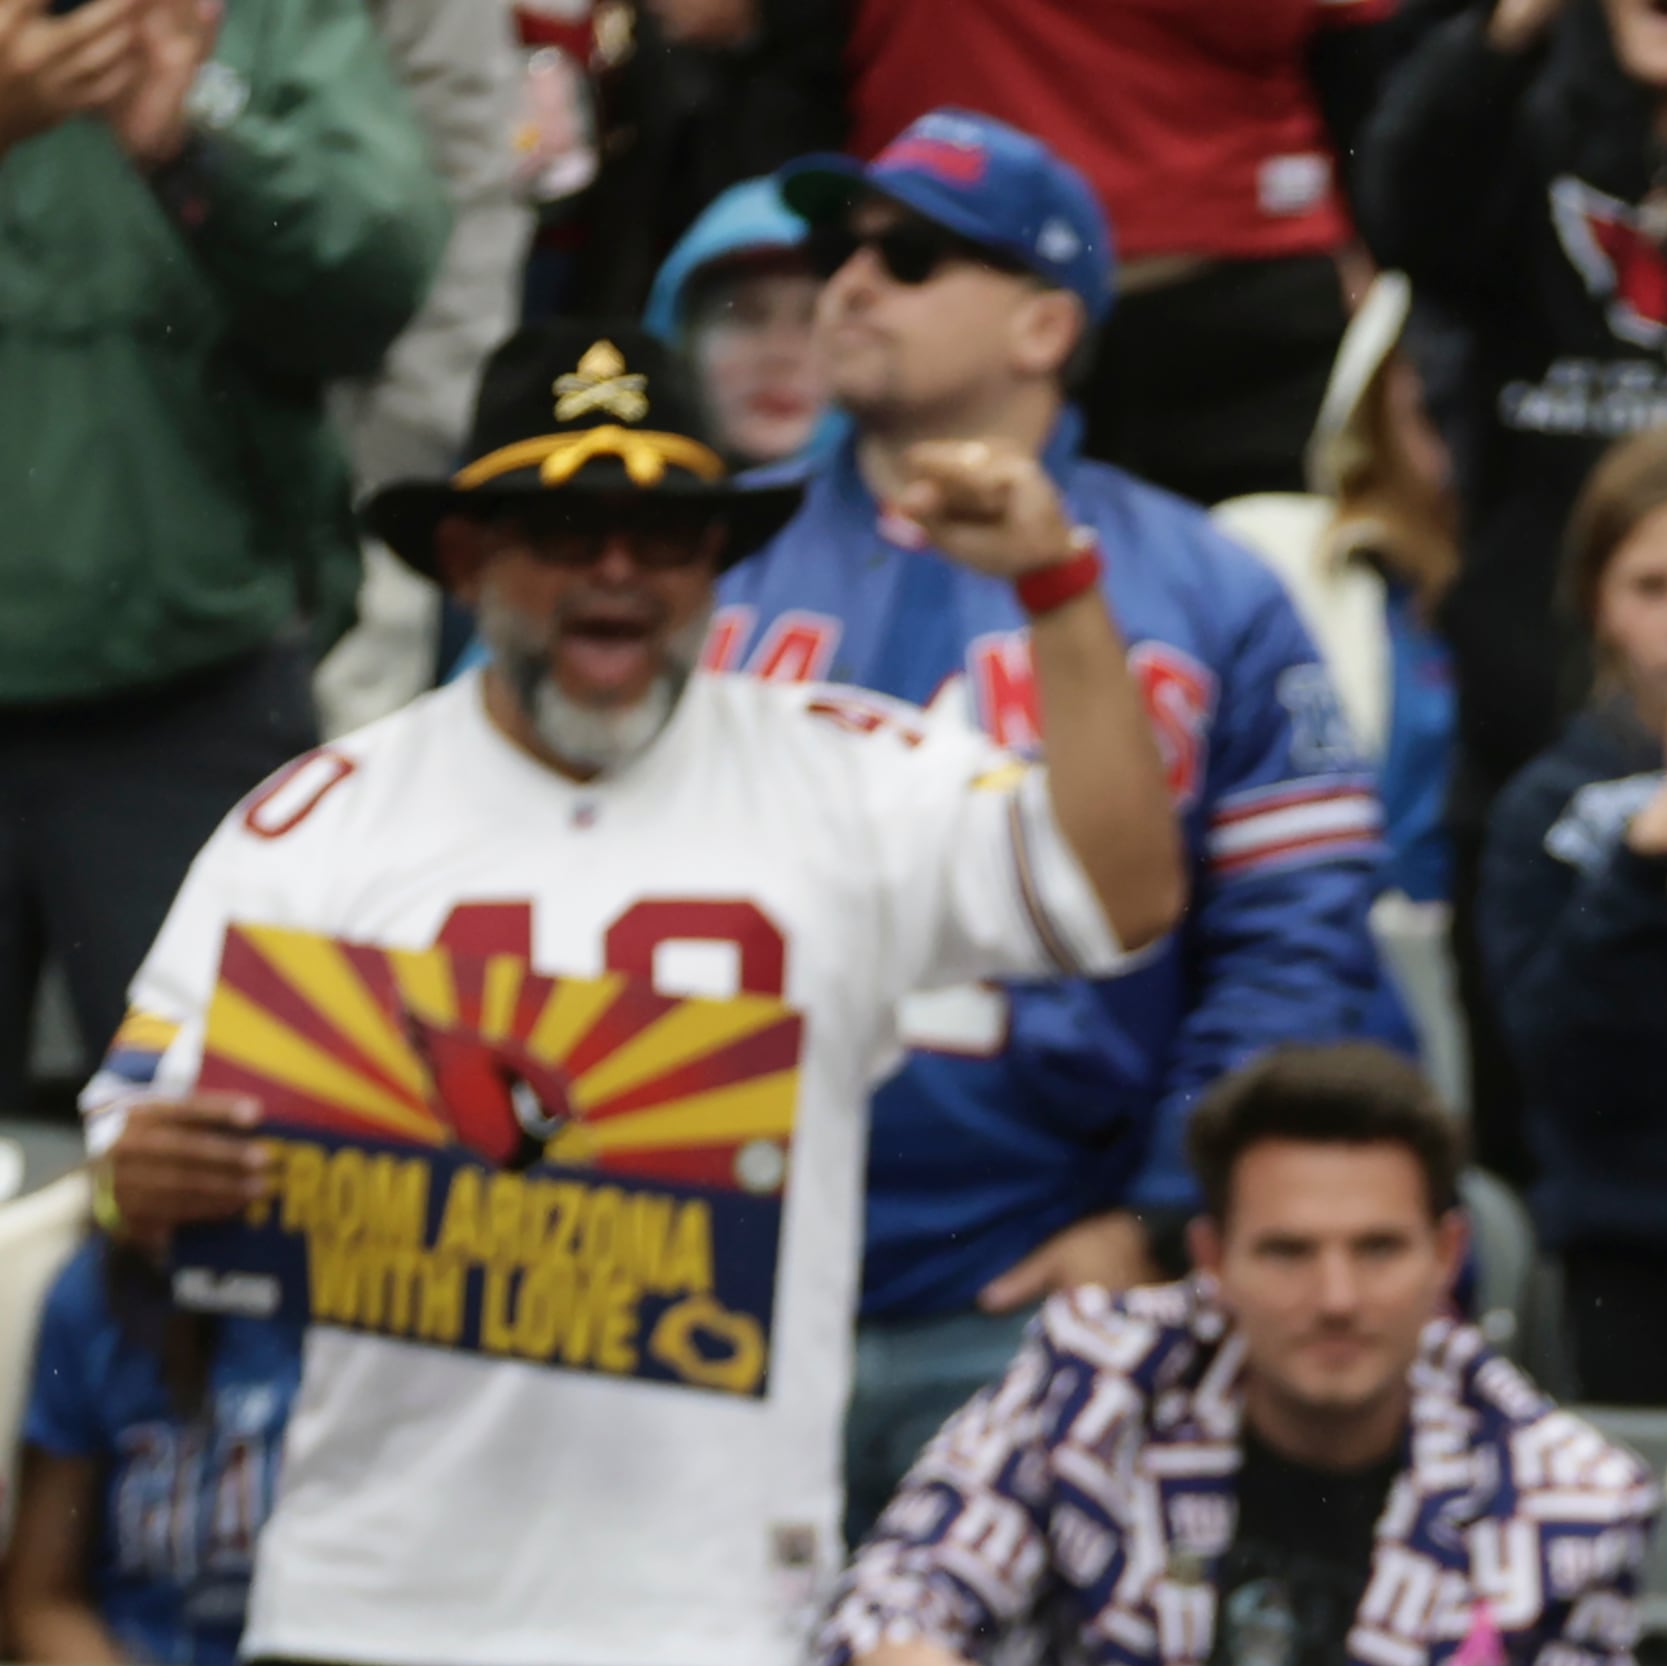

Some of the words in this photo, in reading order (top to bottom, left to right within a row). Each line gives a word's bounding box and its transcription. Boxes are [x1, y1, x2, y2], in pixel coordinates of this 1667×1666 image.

[306, 1222, 467, 1346] WITH
[479, 1258, 642, 1373] LOVE
[436, 1164, 714, 1294] ARIZONA
